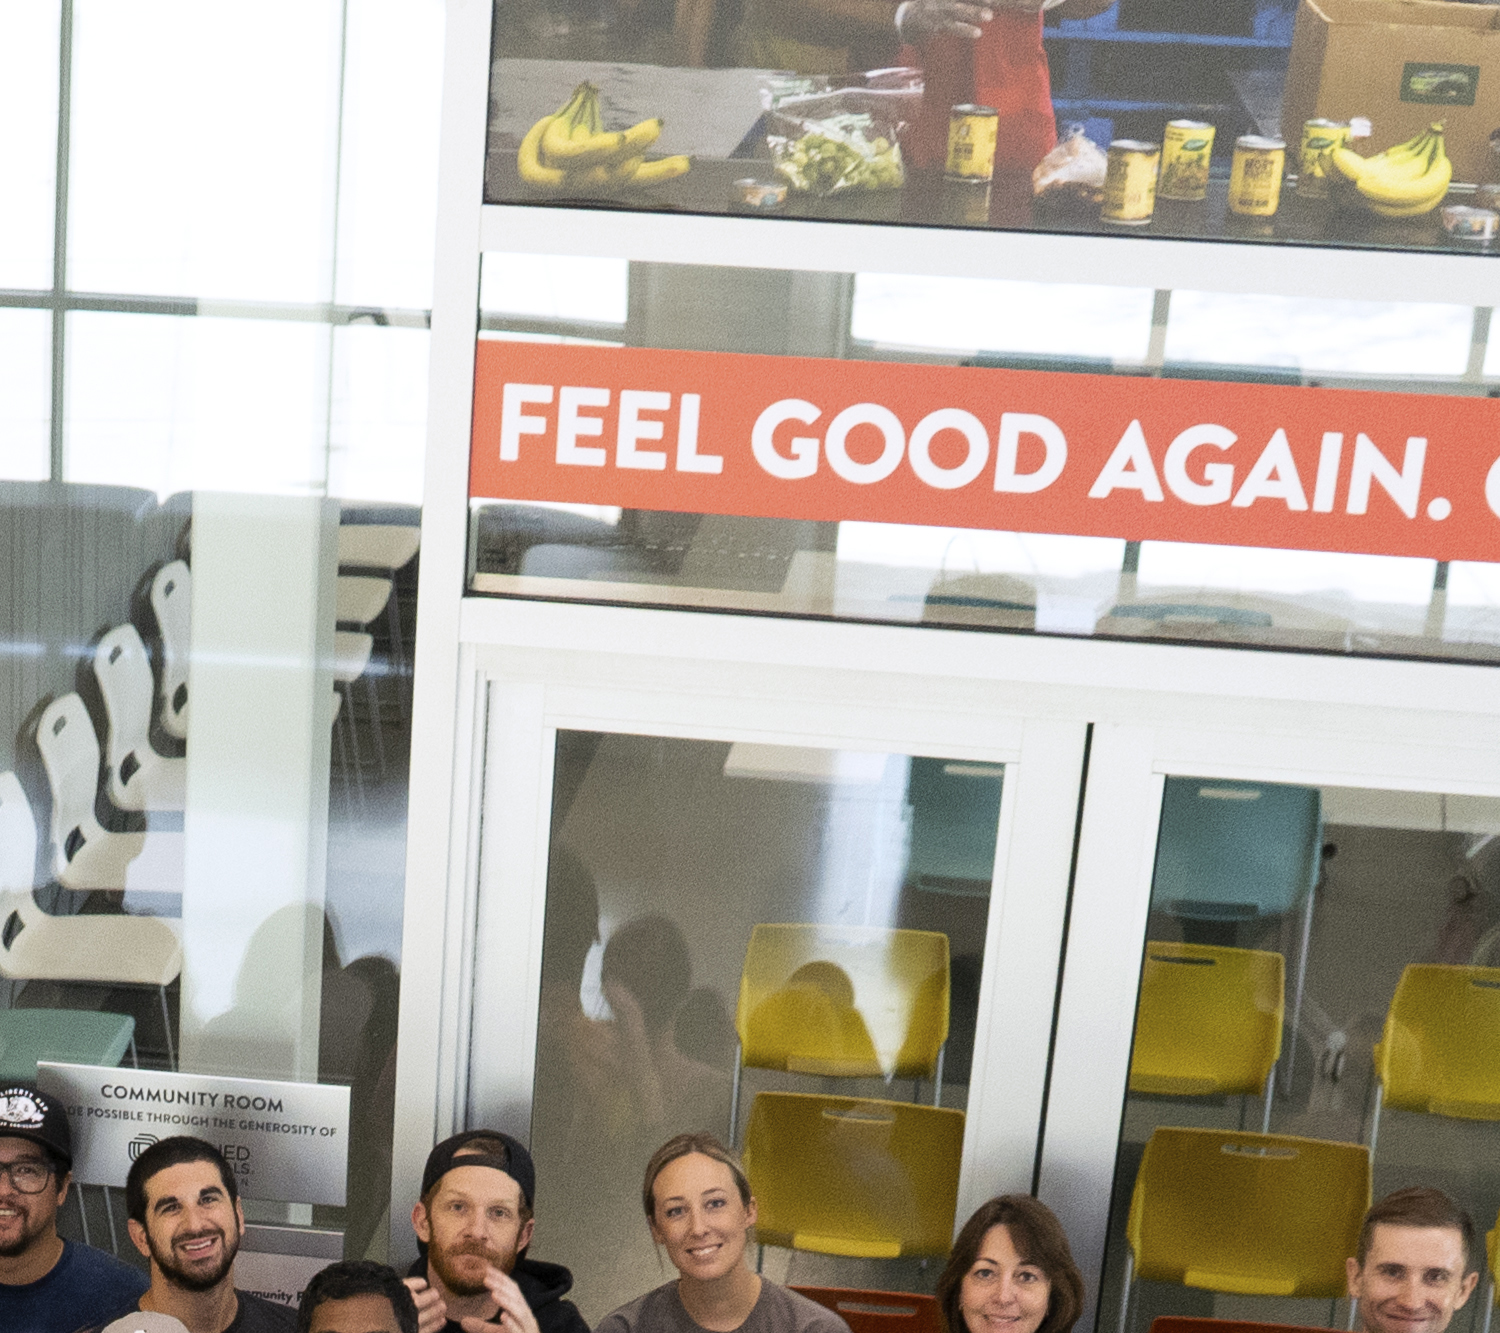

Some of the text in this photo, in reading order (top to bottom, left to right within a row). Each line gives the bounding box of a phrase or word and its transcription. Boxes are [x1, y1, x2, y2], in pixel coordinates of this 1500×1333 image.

[498, 380, 726, 476] FEEL
[748, 395, 1071, 499] GOOD
[1088, 418, 1453, 523] AGAIN.
[99, 1082, 284, 1113] COMMUNITY ROOM
[85, 1105, 144, 1122] POSSIBLE
[145, 1112, 210, 1128] THROUGH
[211, 1117, 237, 1130] THE
[238, 1119, 317, 1137] GENEROSITY
[318, 1126, 339, 1138] OF
